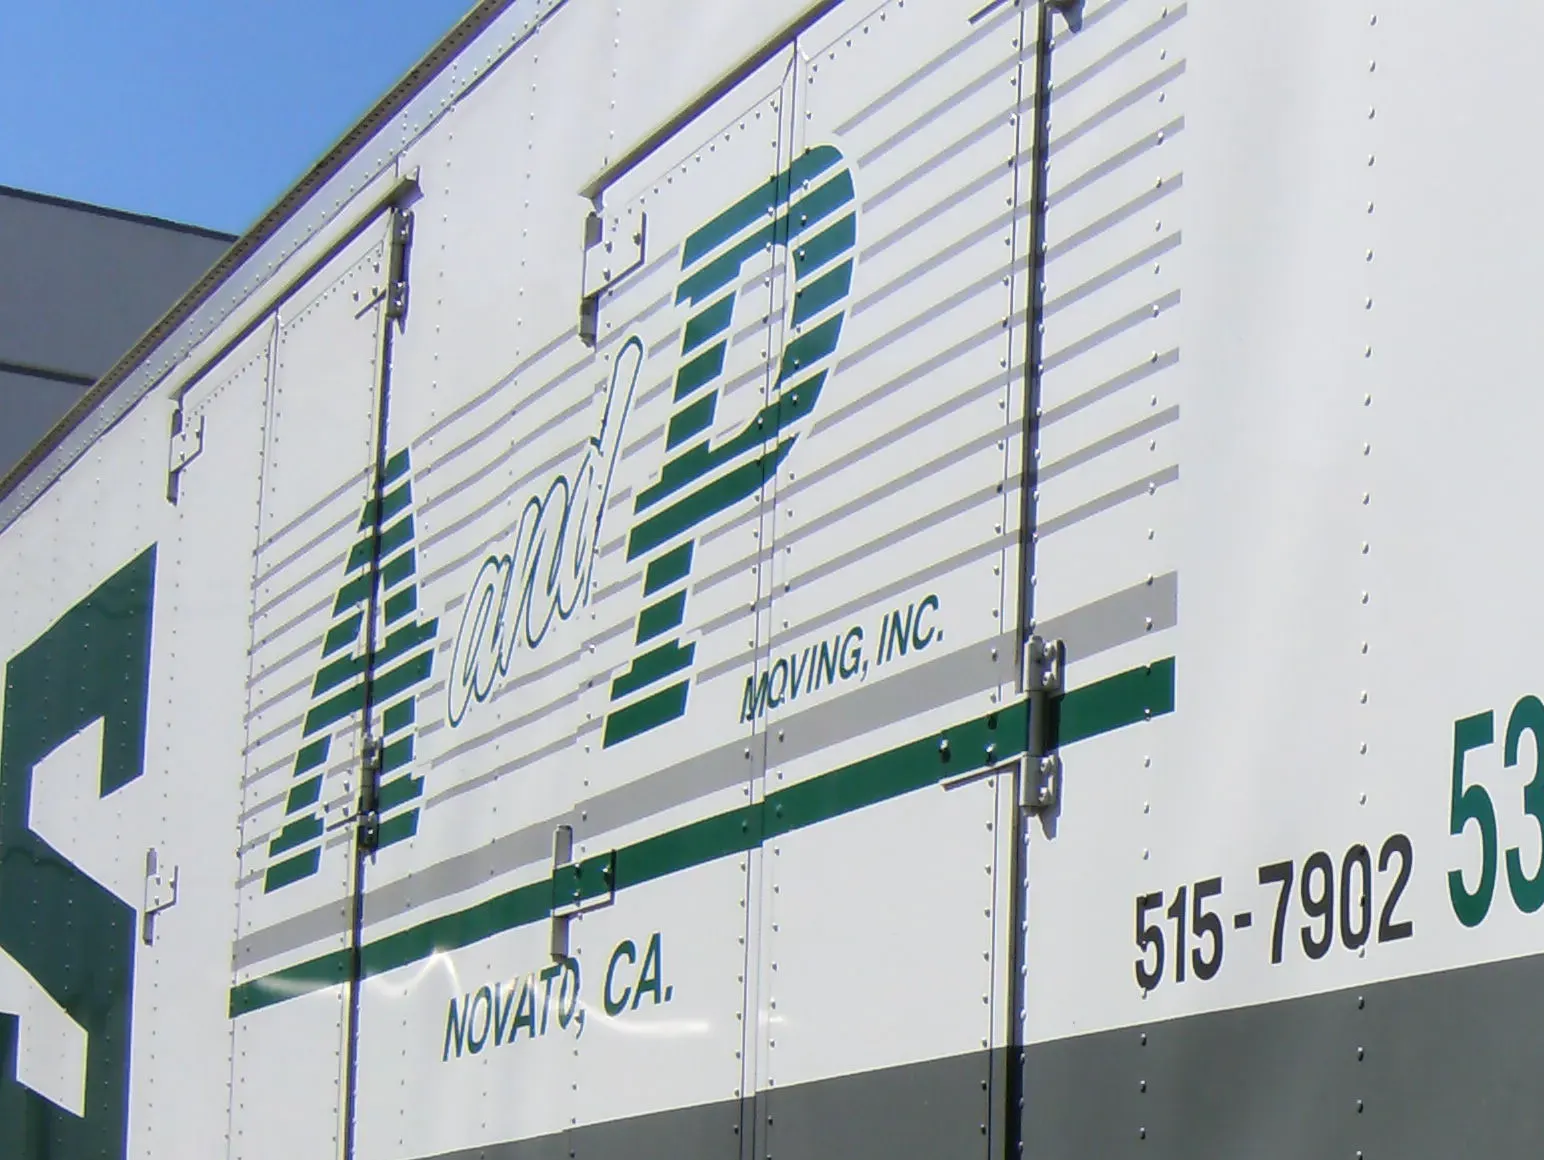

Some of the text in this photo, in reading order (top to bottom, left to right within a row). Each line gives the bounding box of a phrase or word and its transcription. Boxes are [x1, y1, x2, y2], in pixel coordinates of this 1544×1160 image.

[739, 593, 944, 724] MOVING, INC.
[1134, 833, 1414, 992] 515-7902
[441, 931, 674, 1063] NOVATO, CA.
